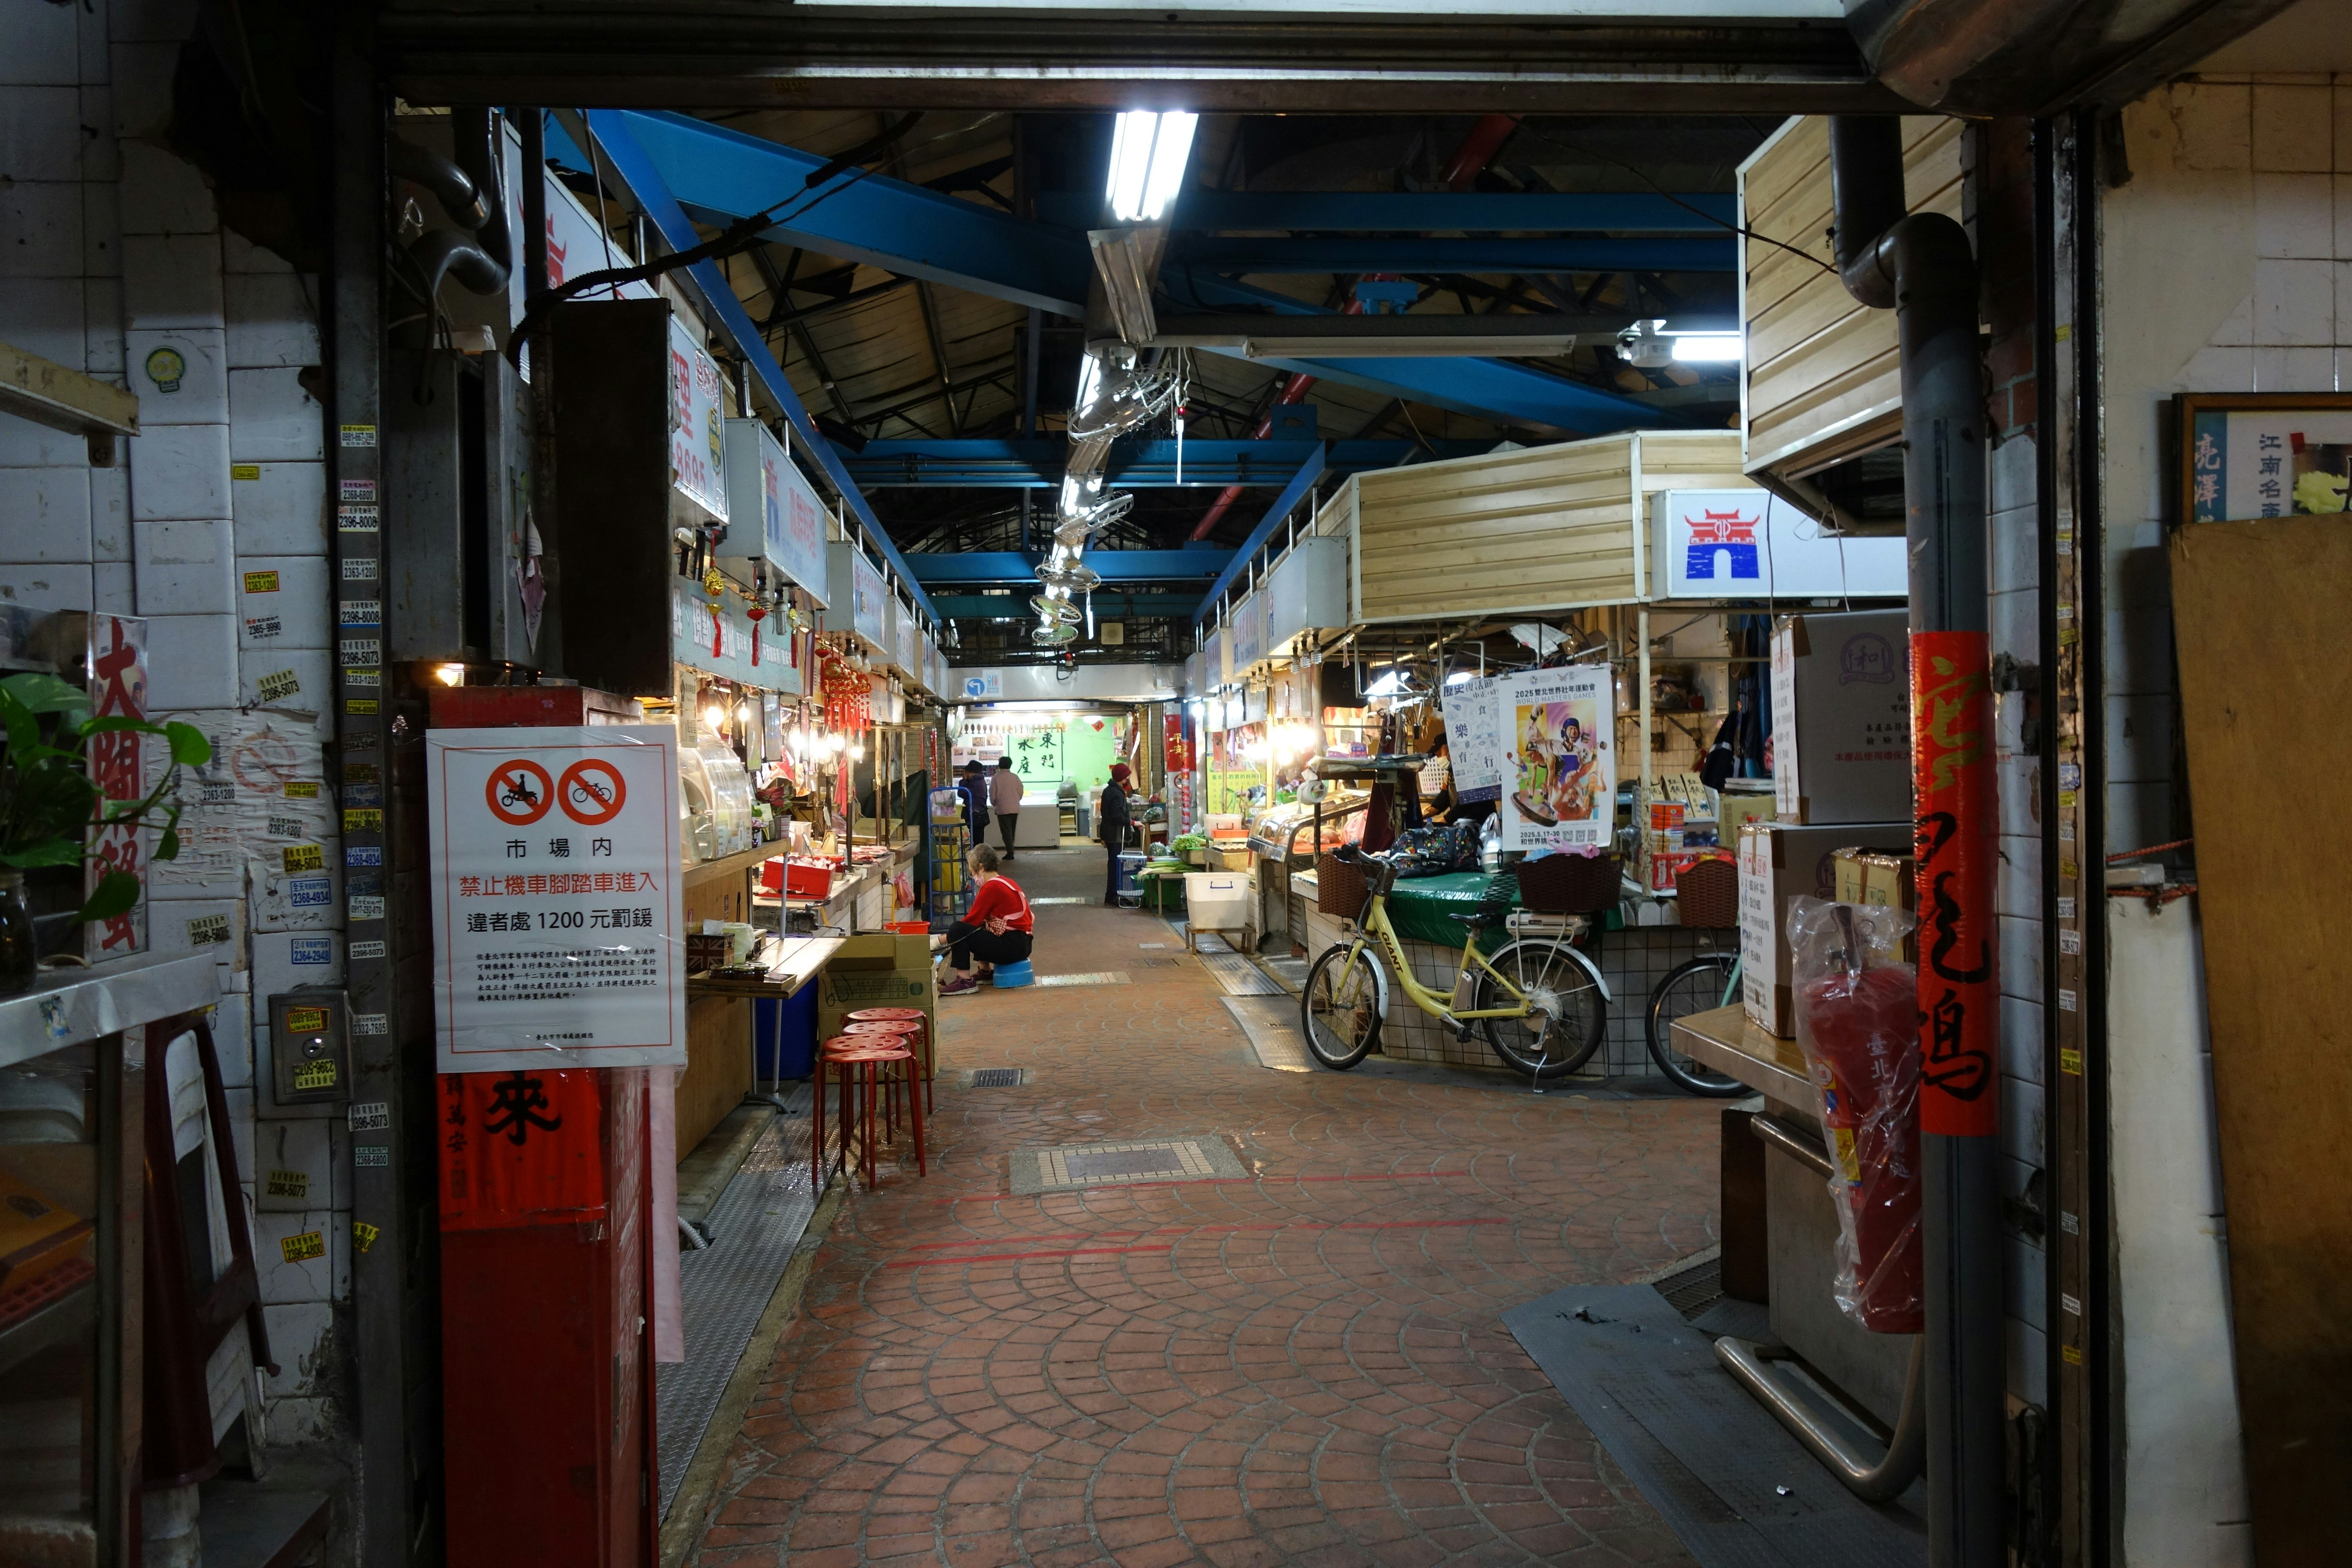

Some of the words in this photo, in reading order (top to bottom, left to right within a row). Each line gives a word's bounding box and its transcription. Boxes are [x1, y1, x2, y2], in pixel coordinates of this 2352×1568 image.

[340, 516, 377, 528] 2396-8008
[344, 567, 375, 577] 2363-1200
[342, 611, 378, 623] 2396-8008
[342, 652, 378, 664] 2396-5073
[347, 675, 378, 684] 2363-1200
[262, 680, 299, 701] 2396-5073
[1455, 723, 1468, 738] 樂
[1040, 732, 1057, 768] 東門
[1017, 739, 1034, 774] 水產
[1484, 755, 1494, 768] 行
[203, 789, 234, 800] 2363-1200
[285, 856, 322, 872] 2396-5073
[348, 854, 380, 865] 2368-4934
[459, 872, 658, 897] 禁止機車腳踏車進入
[294, 891, 328, 903] 2368-4934
[467, 912, 530, 932] 違者處
[538, 912, 584, 928] 1200
[590, 907, 652, 929] 元罰鍰
[352, 949, 383, 958] 2396-5073
[1381, 931, 1404, 973] GIANT
[357, 1155, 386, 1165] 2368-6800
